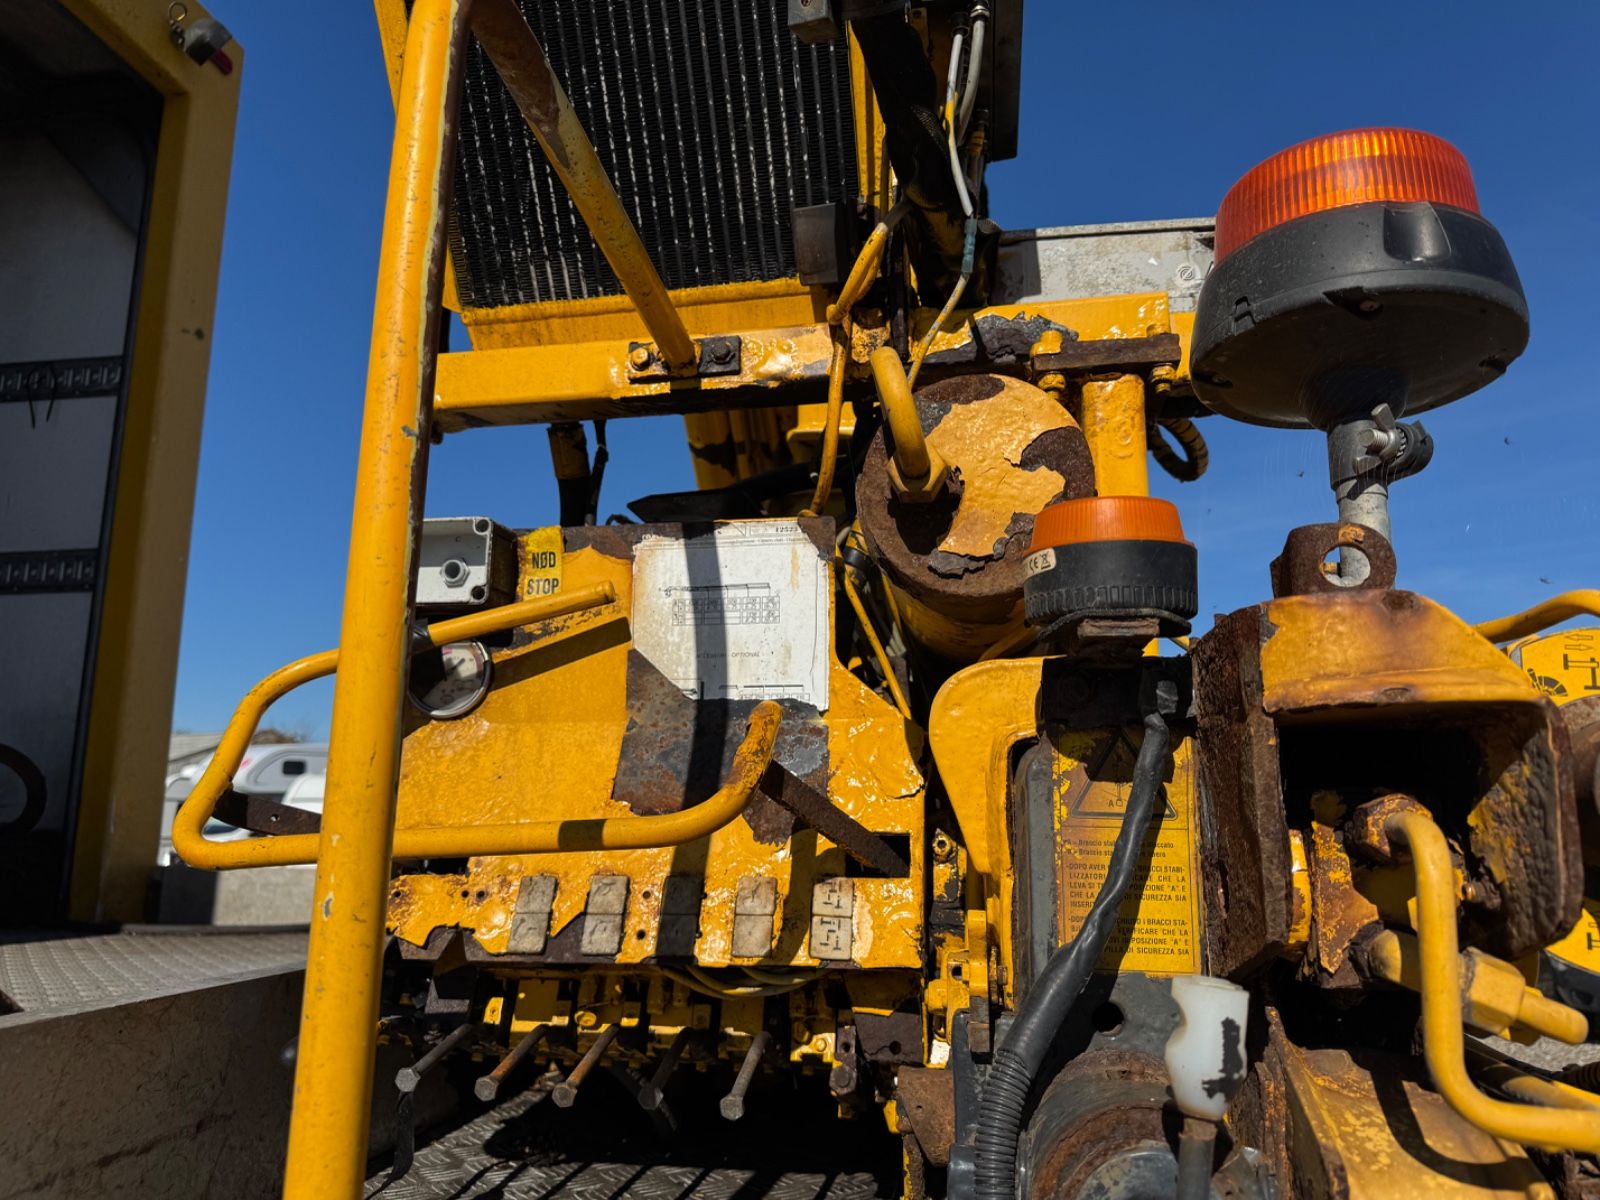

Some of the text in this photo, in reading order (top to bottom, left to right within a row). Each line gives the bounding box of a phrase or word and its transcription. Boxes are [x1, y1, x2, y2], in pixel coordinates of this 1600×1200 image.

[531, 550, 556, 570] NØD
[527, 577, 560, 595] STOP
[1108, 799, 1114, 807] A
[1176, 875, 1186, 883] LA
[1069, 881, 1086, 889] LEVA
[1086, 891, 1095, 899] LA
[1174, 894, 1187, 902] SIA
[1147, 918, 1171, 926] BRACCI
[1162, 928, 1175, 936] CHE
[1136, 947, 1174, 955] SICUREZZA
[1177, 948, 1190, 956] SIA
